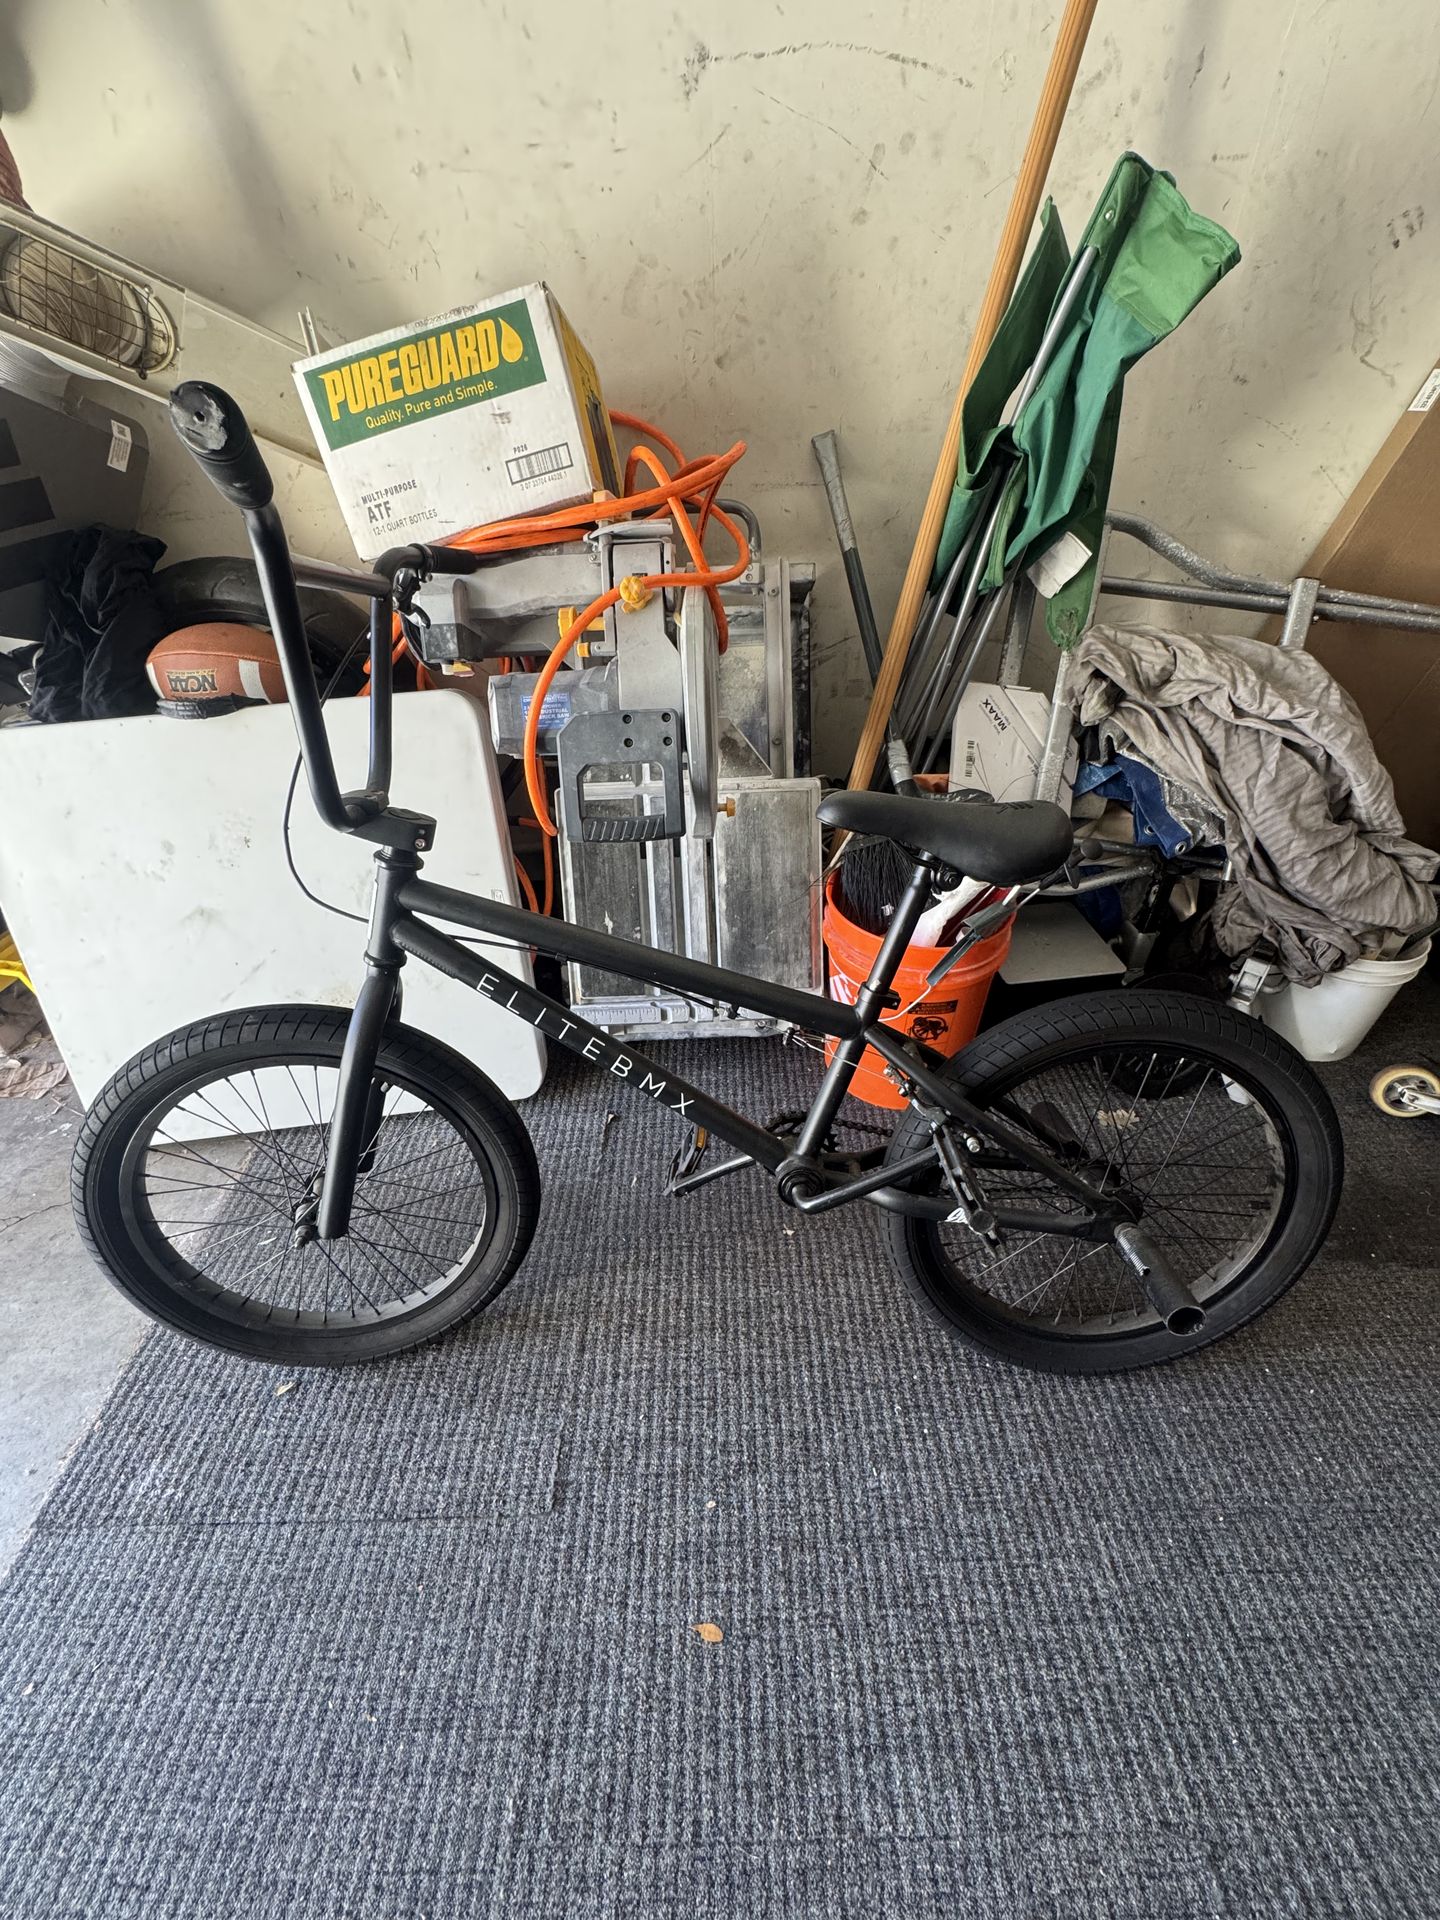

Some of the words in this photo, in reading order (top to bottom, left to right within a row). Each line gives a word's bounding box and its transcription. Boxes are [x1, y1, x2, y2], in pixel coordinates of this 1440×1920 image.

[318, 318, 500, 422] PUREGUARD
[365, 409, 404, 429] Quality.
[404, 402, 432, 416] Pure
[434, 391, 455, 407] and
[455, 379, 498, 401] Simple.
[361, 479, 418, 505] MULTI-PURPOSE
[367, 500, 392, 524] ATF
[372, 526, 387, 537] 12-1
[386, 517, 408, 532] QUART
[409, 508, 438, 525] BOTTLES
[166, 673, 218, 693] NCAA
[982, 698, 1008, 732] MAAX
[476, 973, 695, 1115] ELITEBMX
